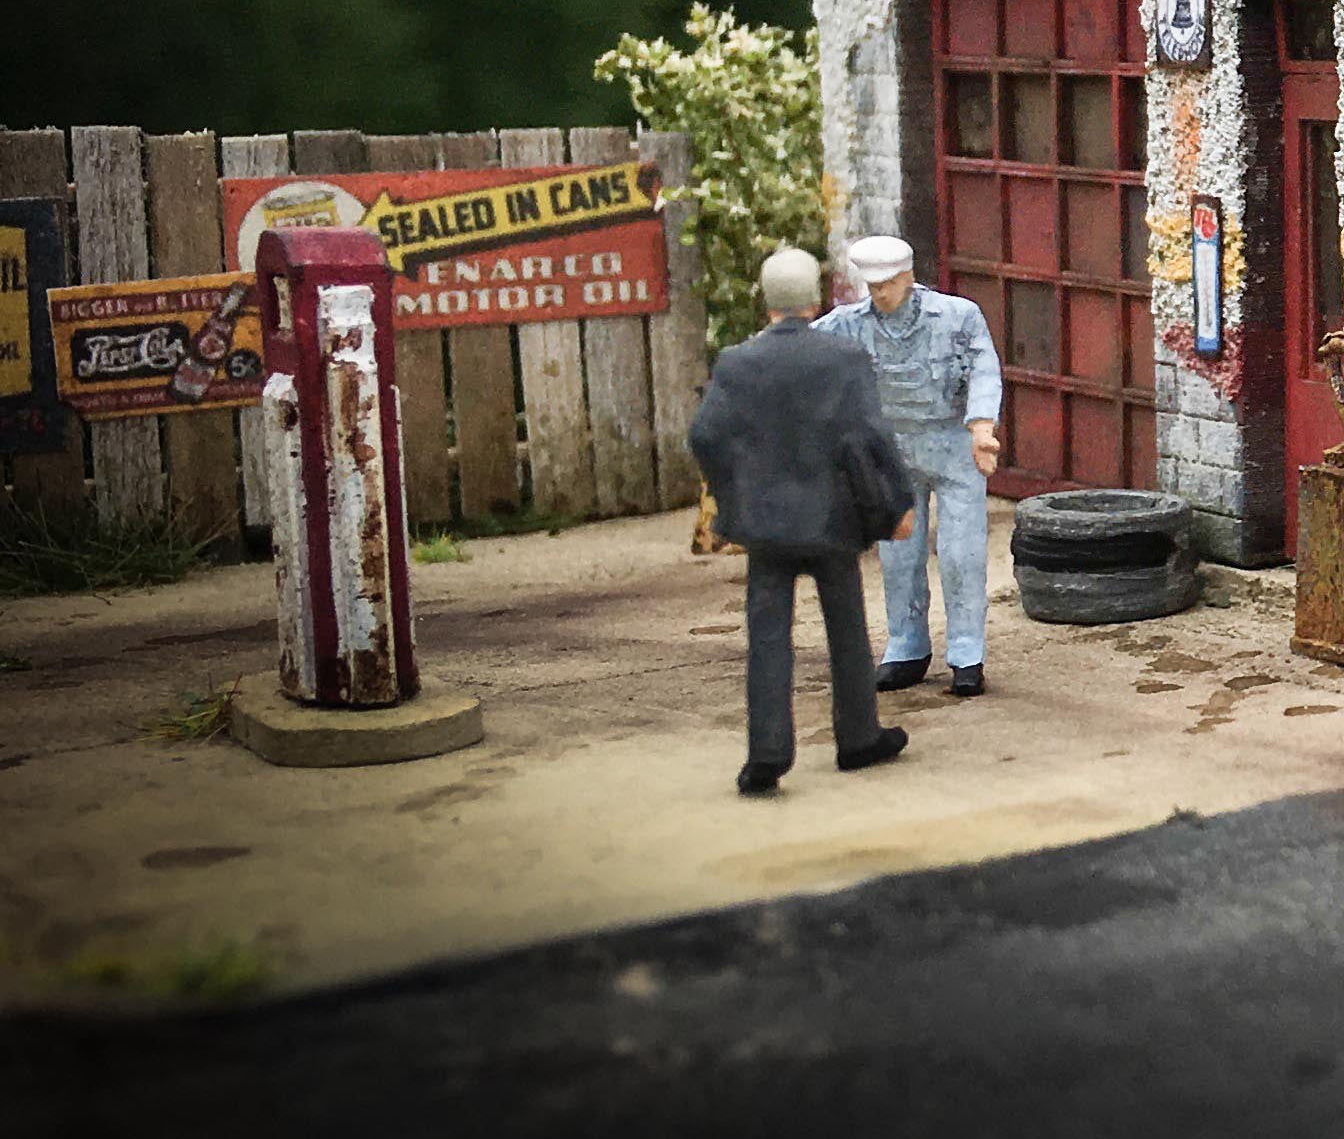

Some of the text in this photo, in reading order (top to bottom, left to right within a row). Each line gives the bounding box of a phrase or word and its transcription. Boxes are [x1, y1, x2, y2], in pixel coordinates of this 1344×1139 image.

[377, 169, 631, 248] SEALED IN CANS
[398, 278, 652, 318] MOTOR OIL
